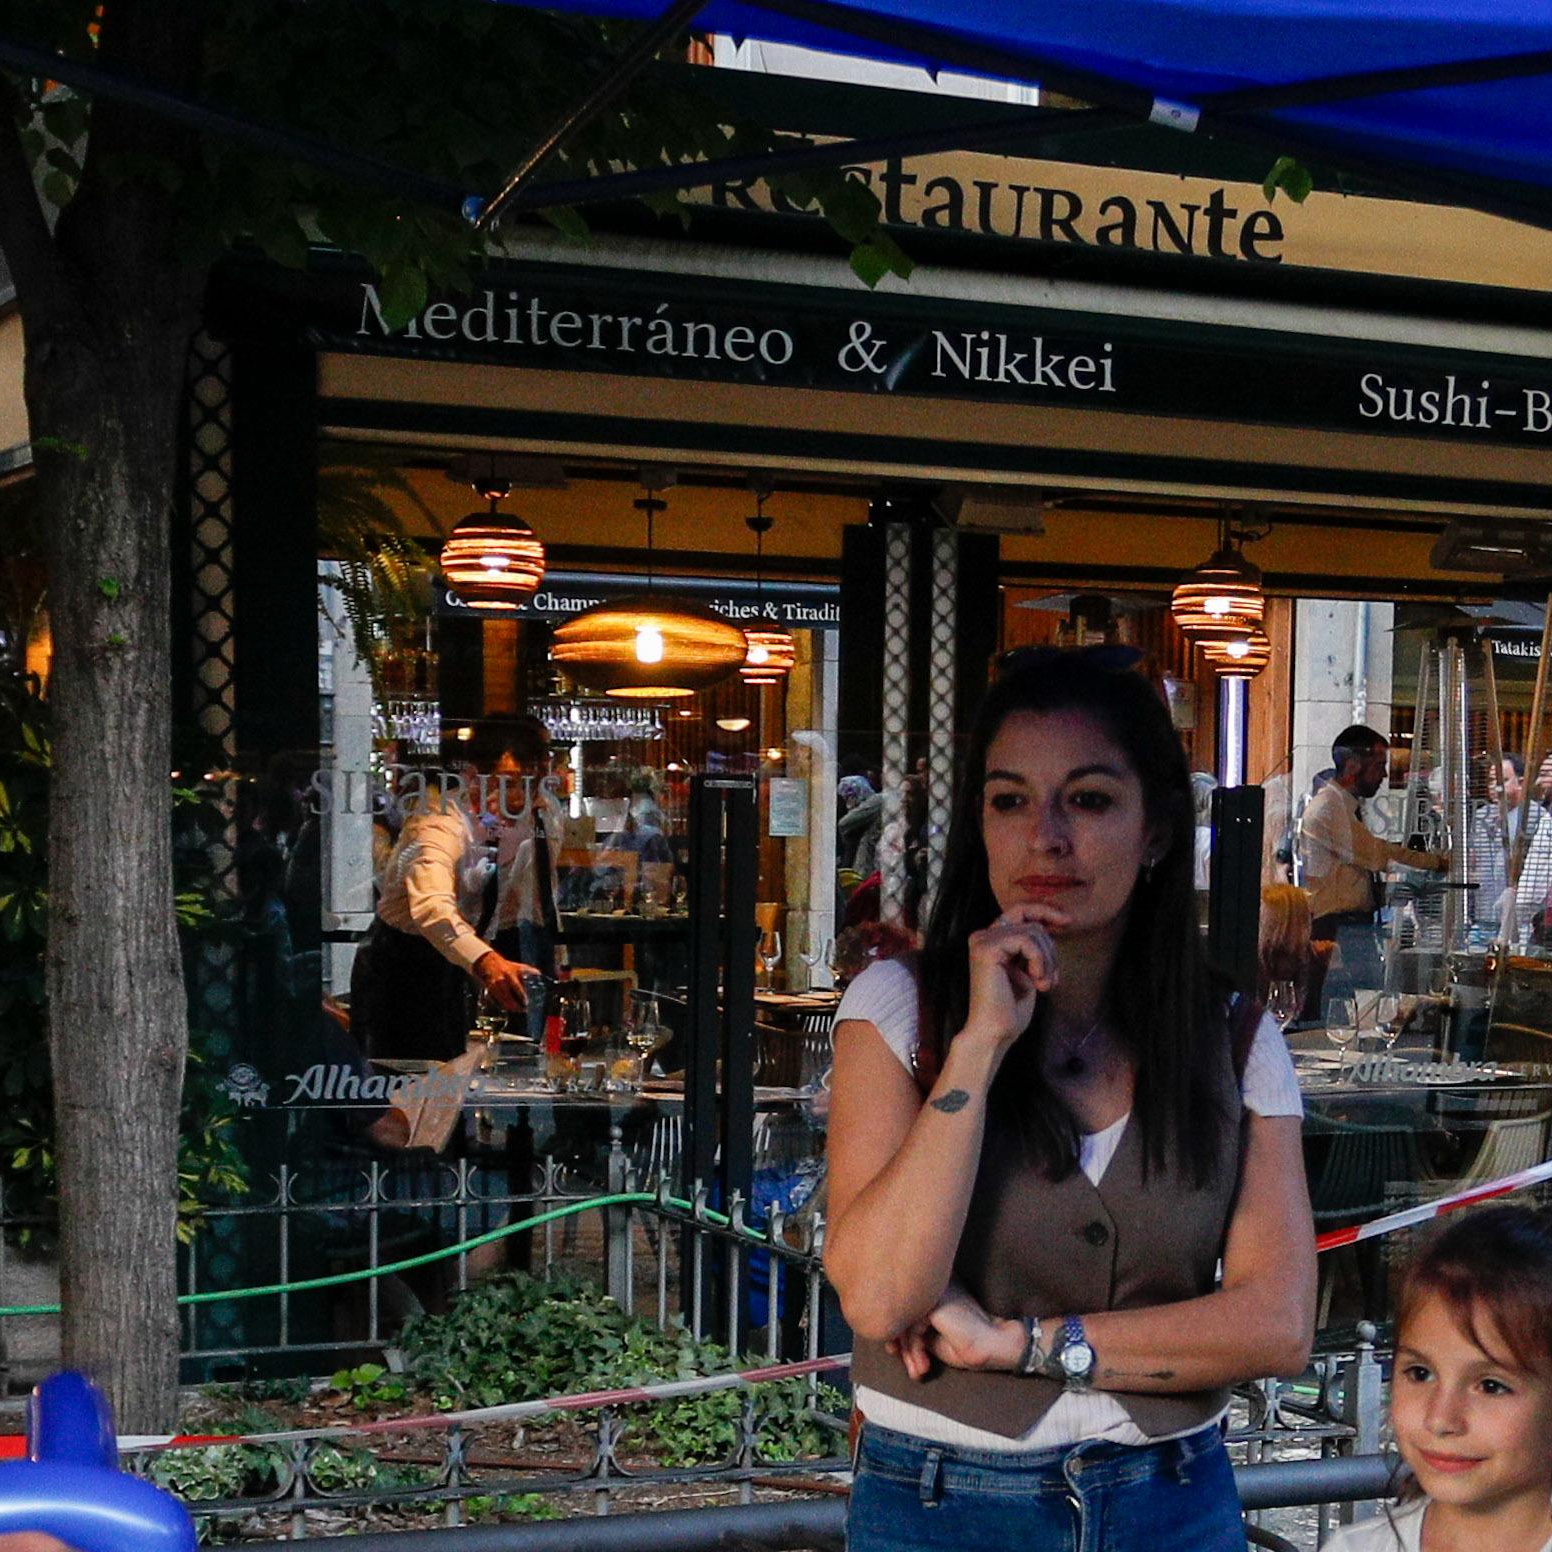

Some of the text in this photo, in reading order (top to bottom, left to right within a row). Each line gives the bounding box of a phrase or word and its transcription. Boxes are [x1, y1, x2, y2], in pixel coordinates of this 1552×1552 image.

[359, 284, 794, 366] Mediterráneo
[838, 320, 889, 374] &
[931, 329, 1116, 392] Nikkei
[762, 601, 778, 620] &
[1491, 640, 1542, 657] Tatakis
[283, 1064, 487, 1105] Alhambra
